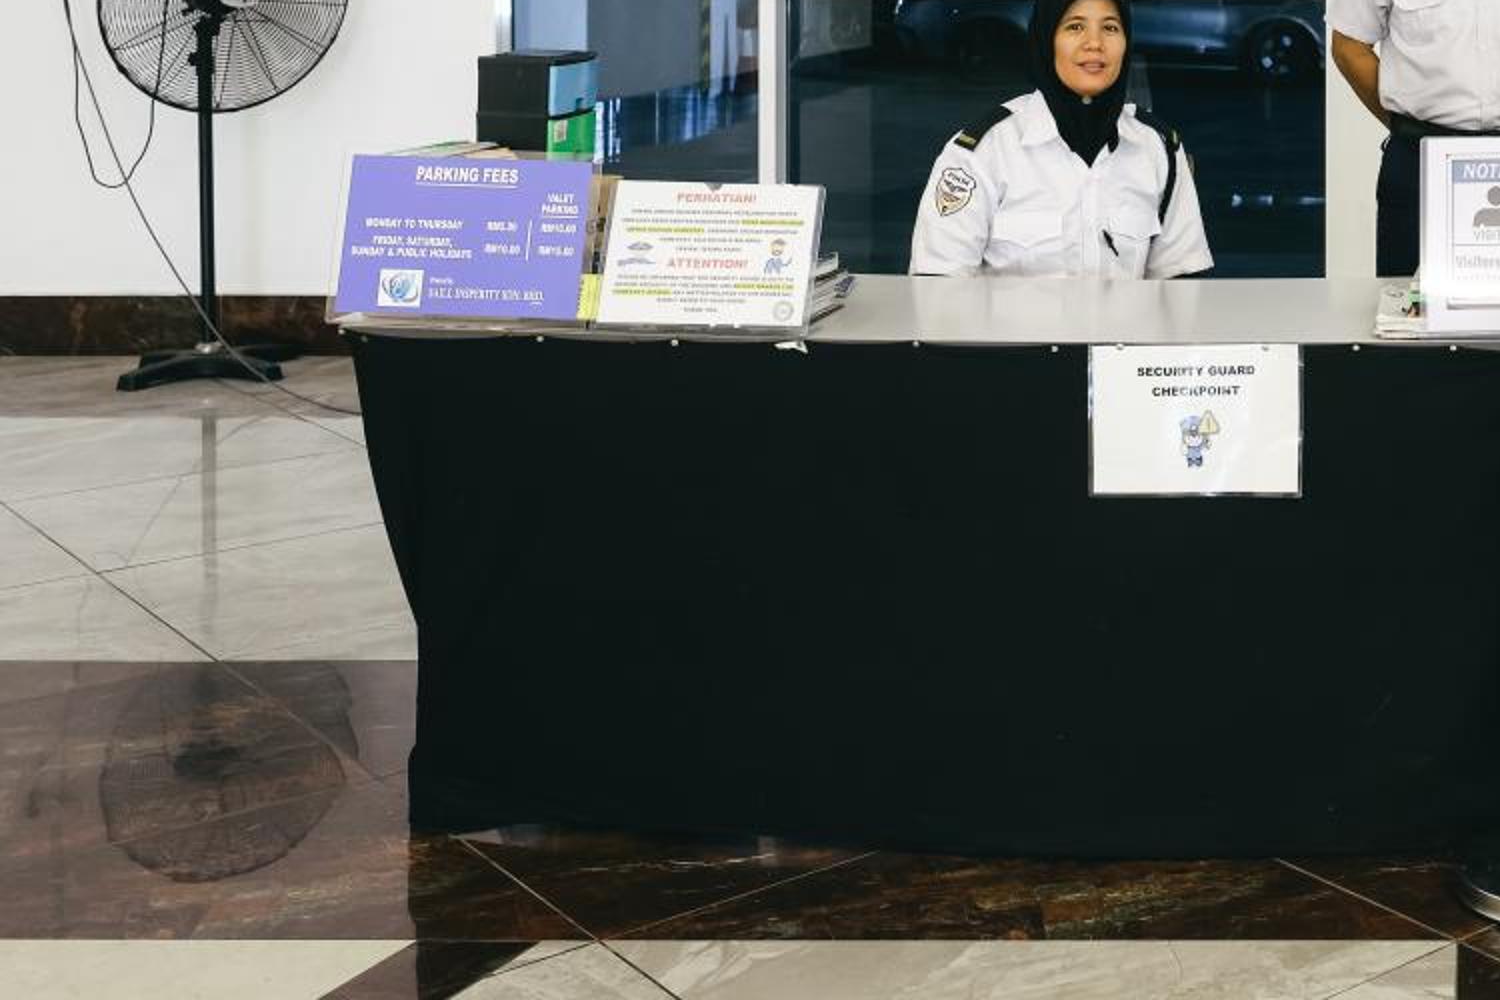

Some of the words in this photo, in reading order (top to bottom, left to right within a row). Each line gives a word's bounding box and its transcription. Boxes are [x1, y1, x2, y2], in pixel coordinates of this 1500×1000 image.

[415, 165, 480, 184] PARKING
[482, 167, 519, 185] FEES
[676, 191, 757, 204] PERHATIAN!
[365, 217, 402, 228] MONDAY
[404, 218, 416, 229] TO
[417, 219, 464, 230] THURSDAY
[351, 245, 385, 256] SUNDAY
[396, 247, 428, 258] PUBLIC
[429, 248, 473, 259] HOLIDAYS
[667, 257, 748, 270] ATTENTION!
[1137, 367, 1203, 377] SECURITY
[1207, 365, 1255, 376] GUARD
[1151, 385, 1241, 397] CHECKPOINT
